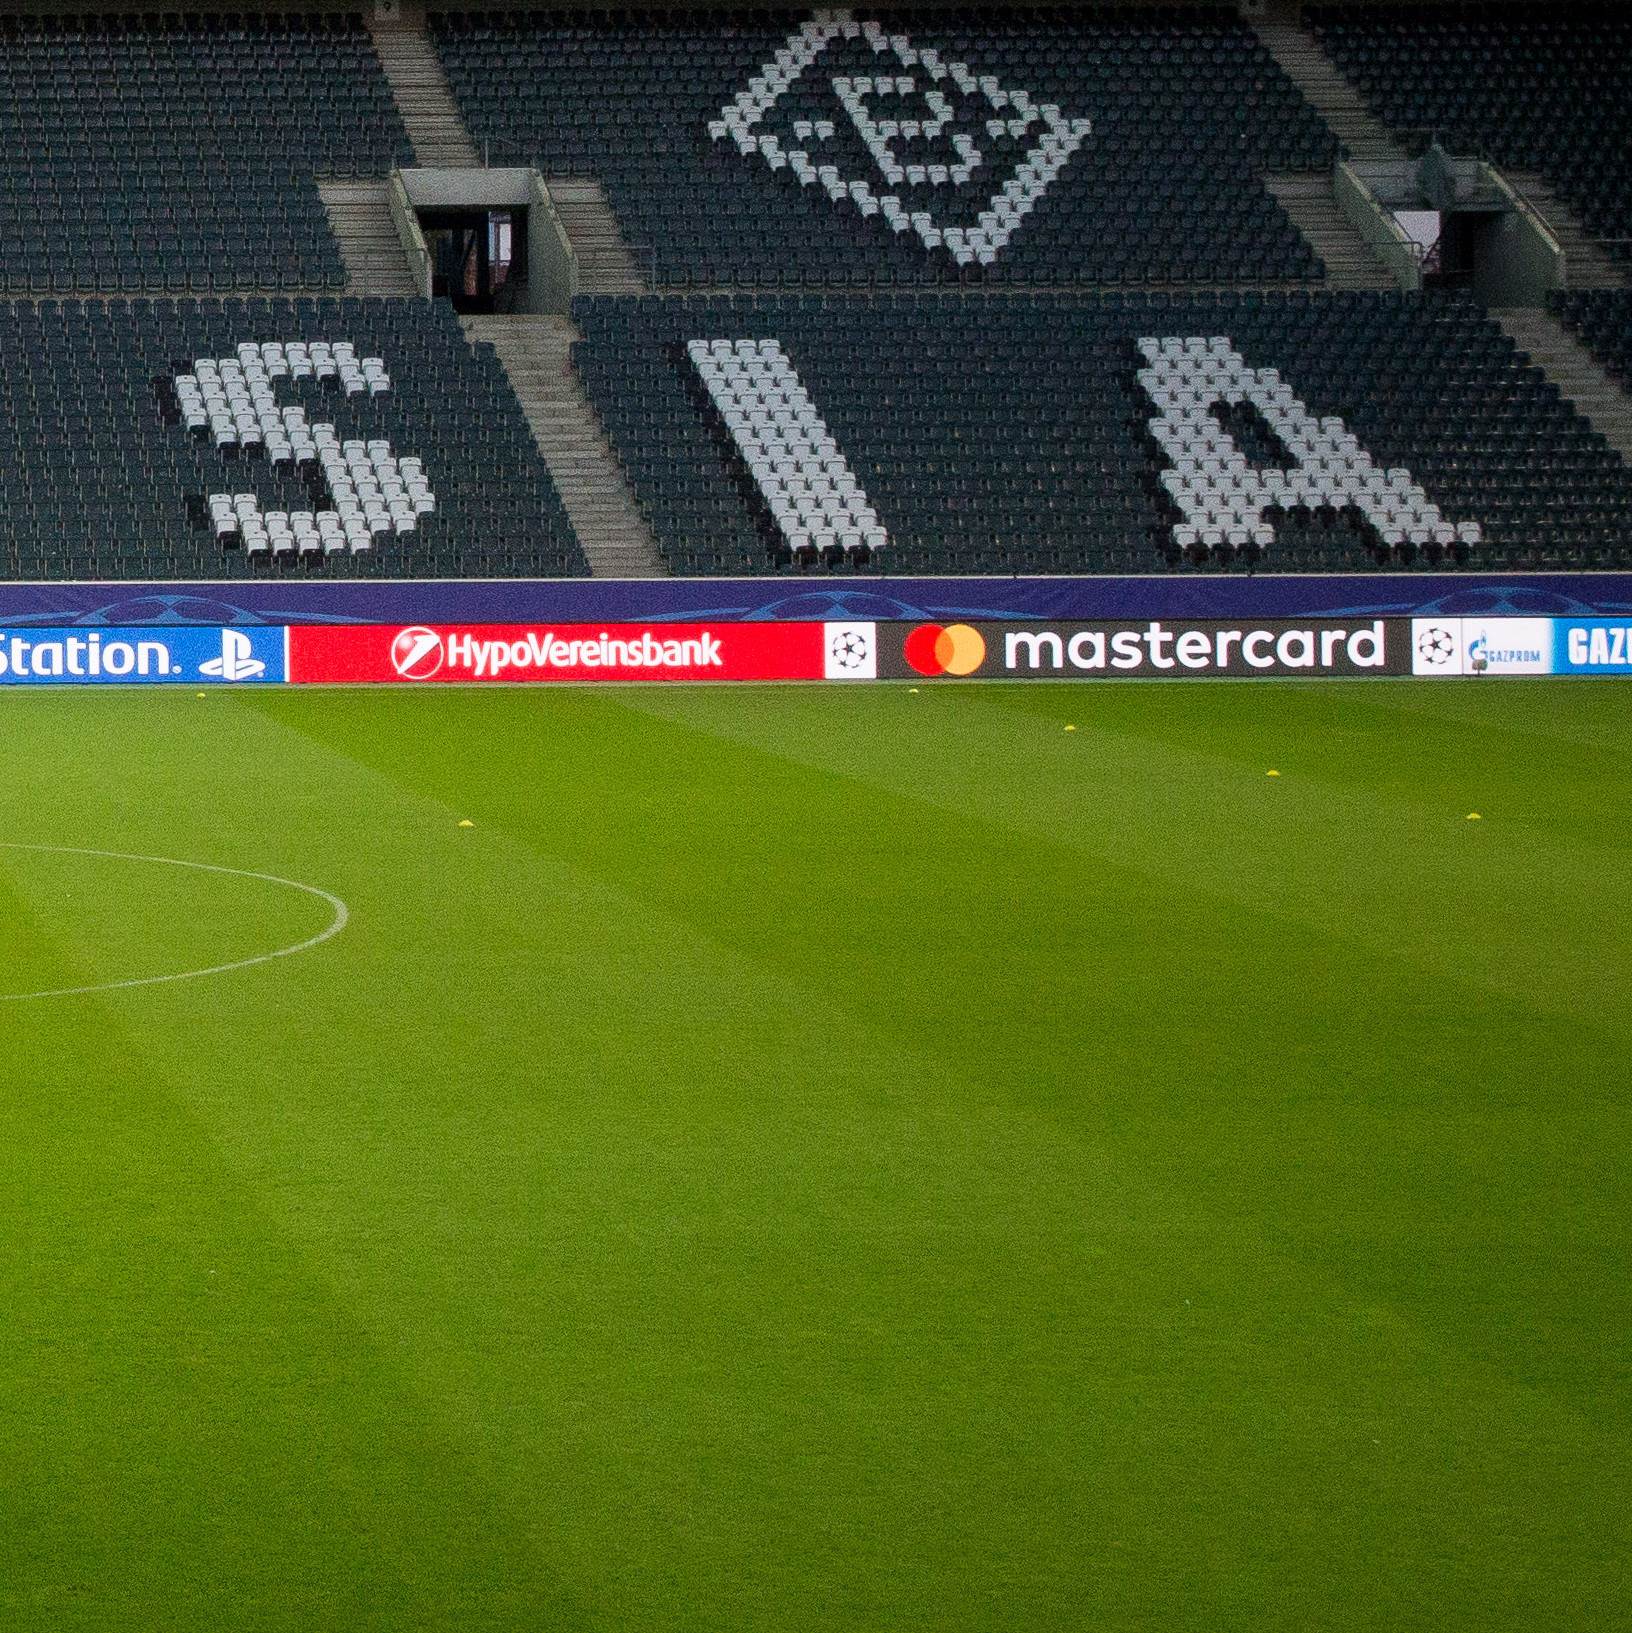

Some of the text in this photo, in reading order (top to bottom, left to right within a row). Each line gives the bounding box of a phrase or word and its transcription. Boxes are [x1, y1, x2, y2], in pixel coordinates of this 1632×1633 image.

[448, 632, 722, 676] HypoVereinsbank
[1005, 622, 1385, 669] mastercard
[1490, 651, 1541, 663] GAZPROM
